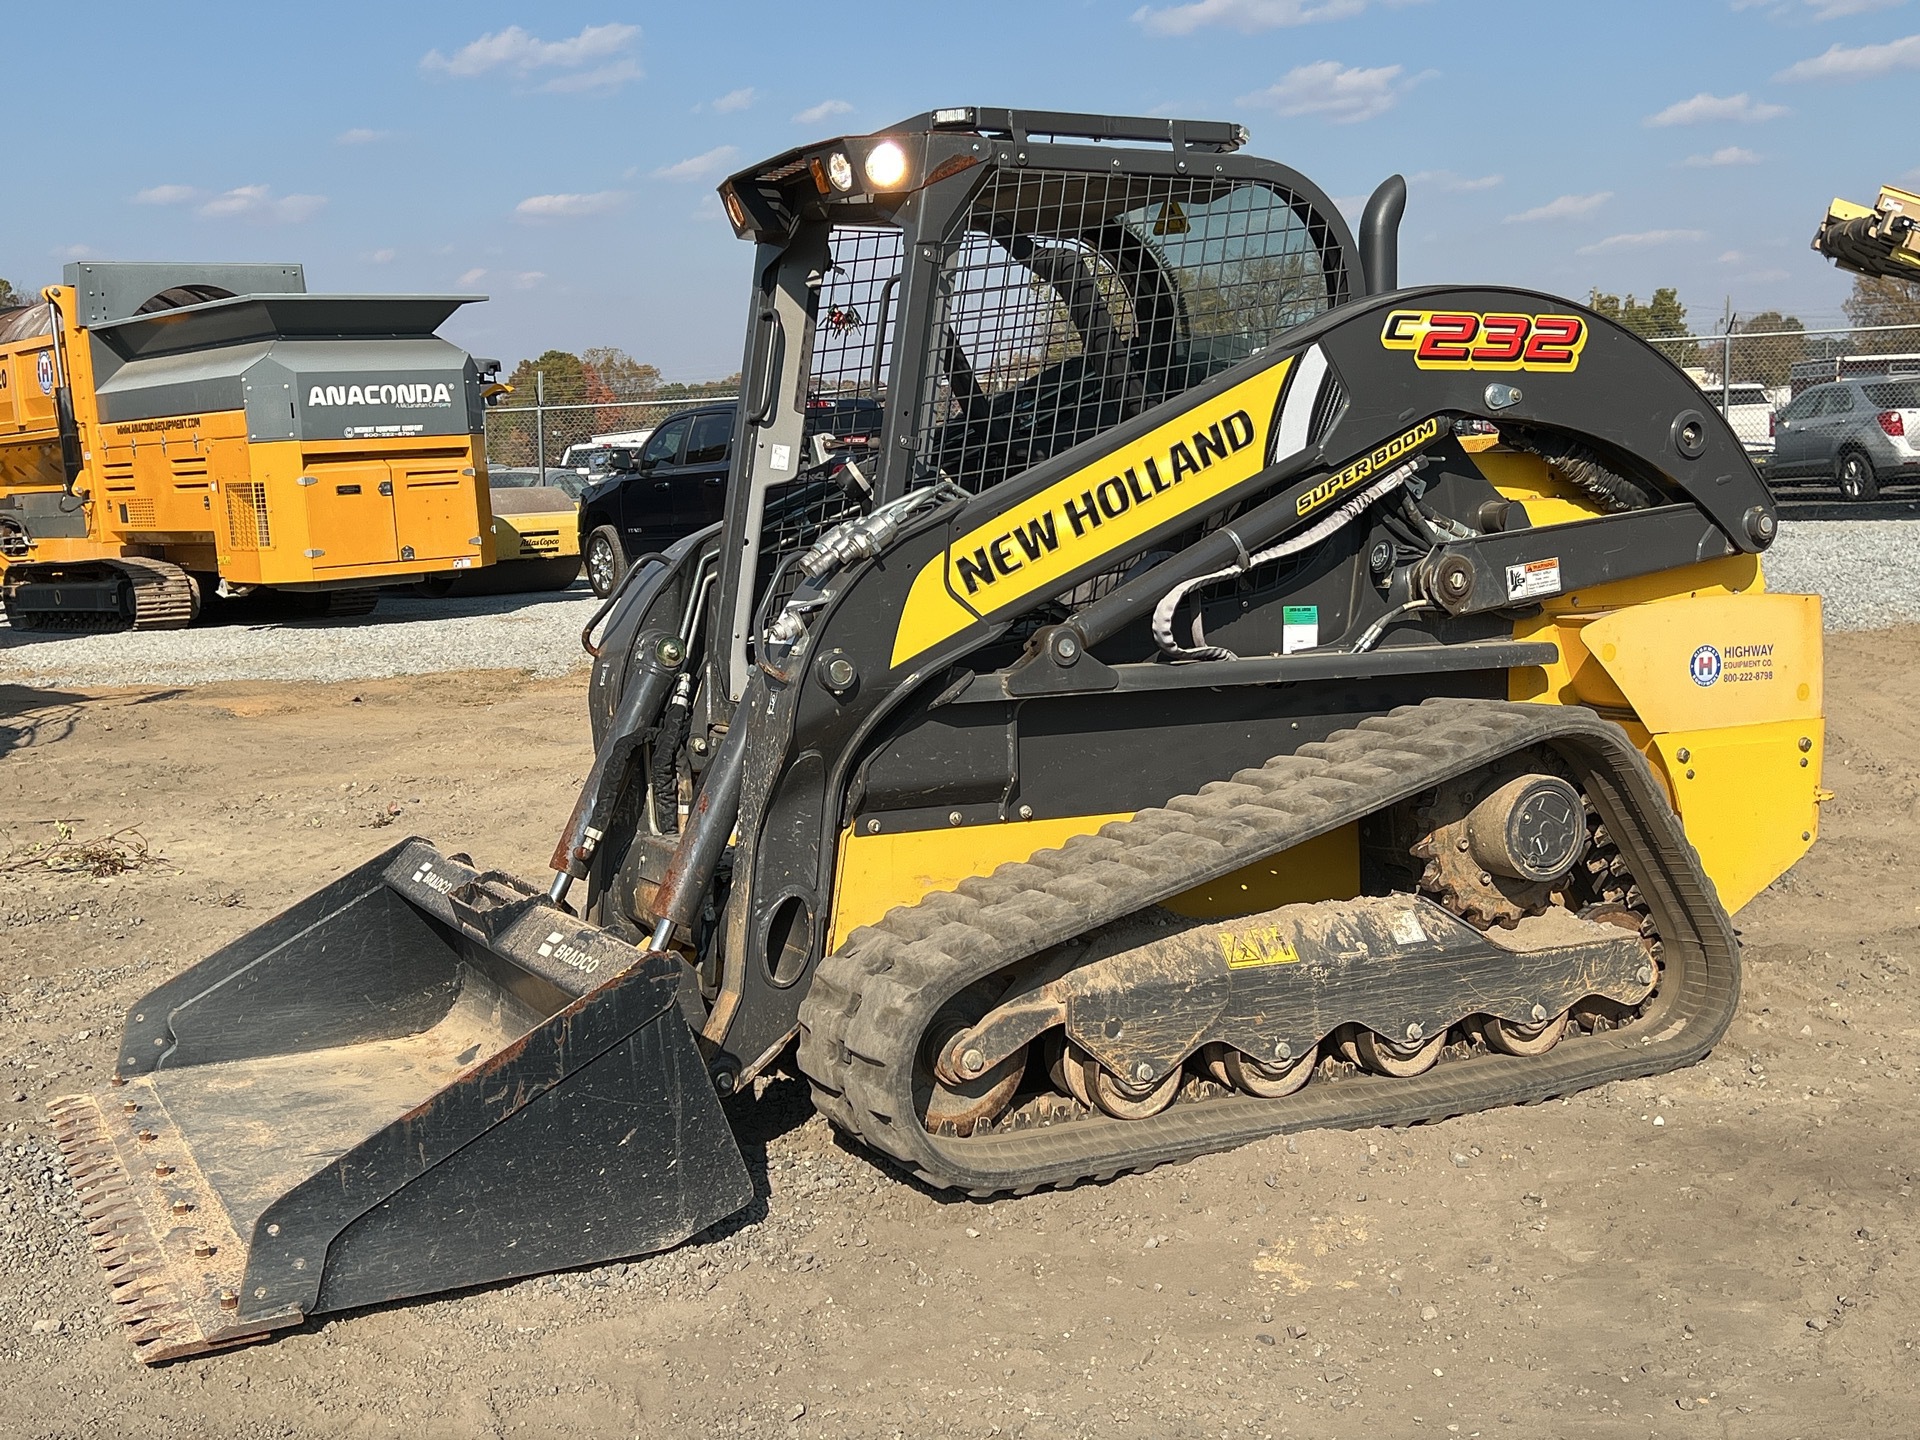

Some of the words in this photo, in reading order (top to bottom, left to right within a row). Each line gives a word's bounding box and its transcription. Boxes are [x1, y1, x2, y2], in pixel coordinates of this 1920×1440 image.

[1384, 314, 1584, 364] C232
[308, 383, 451, 407] ANACONDA
[1298, 459, 1370, 512] SUPER
[1373, 420, 1434, 467] BOOM
[955, 509, 1060, 596] NEW
[1063, 409, 1255, 538] HOLLAND
[520, 539, 540, 547] Atlas
[540, 537, 560, 547] Copco
[1724, 644, 1774, 658] HIGHWAY
[1723, 660, 1761, 669] EQUIPMENT
[1723, 671, 1773, 682] 800-222-8798
[422, 871, 452, 895] BRADCO
[553, 943, 600, 974] BRADCO
